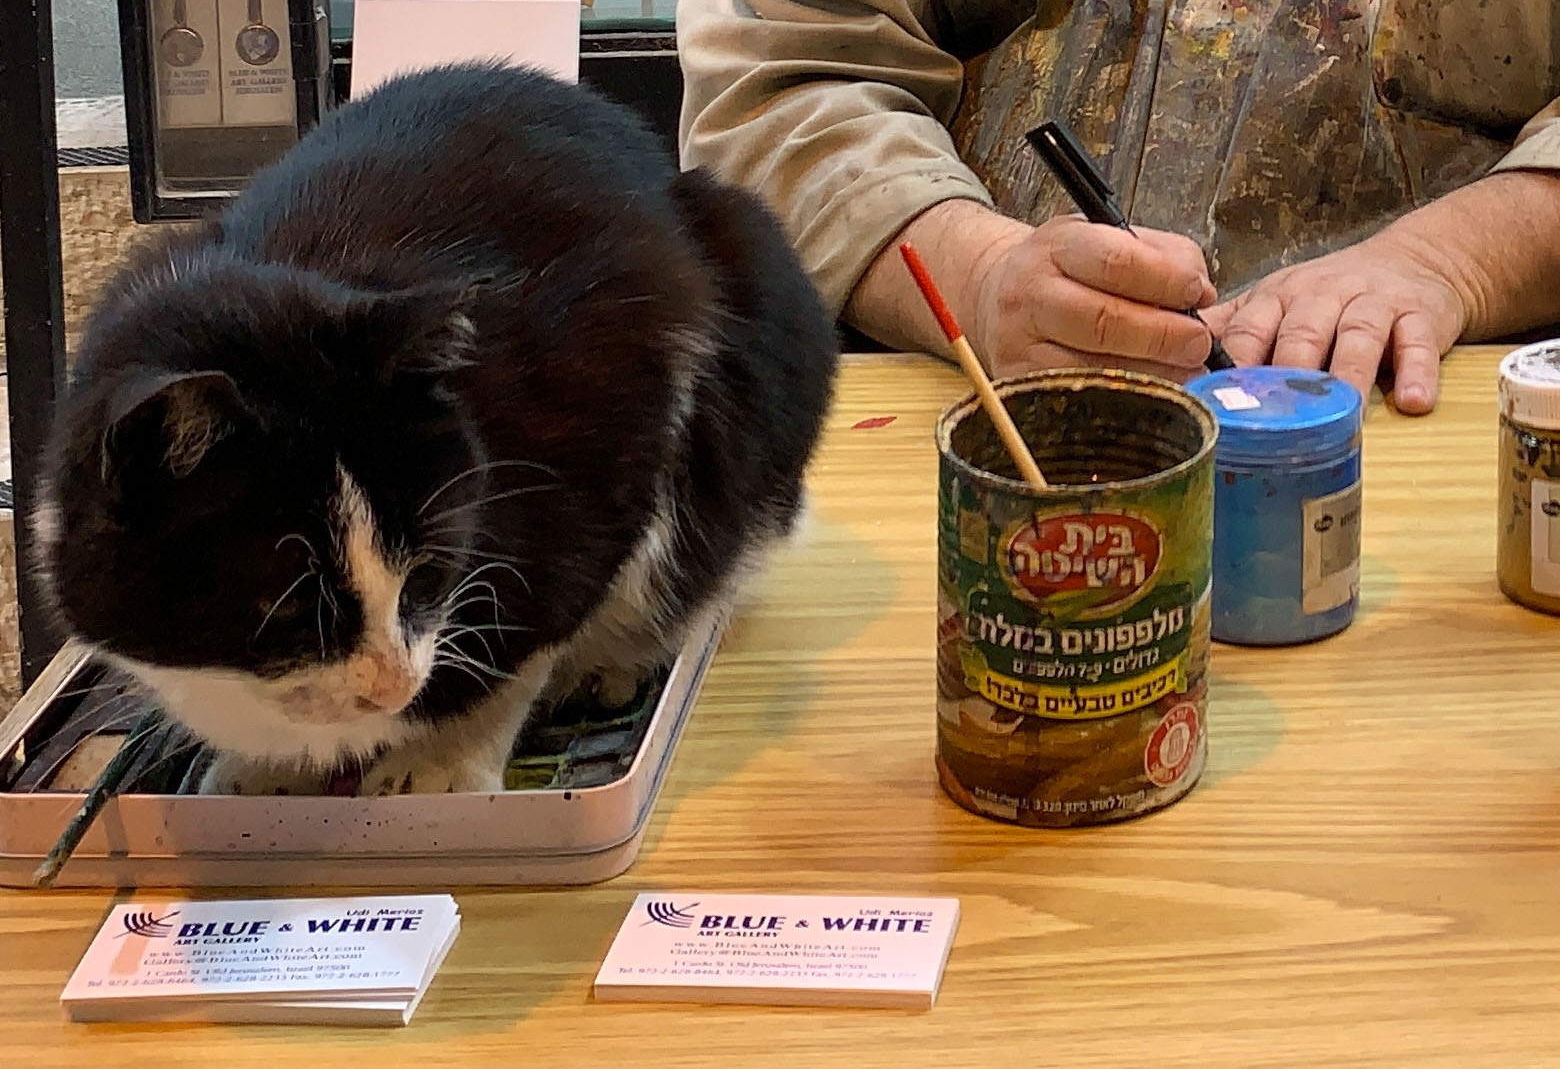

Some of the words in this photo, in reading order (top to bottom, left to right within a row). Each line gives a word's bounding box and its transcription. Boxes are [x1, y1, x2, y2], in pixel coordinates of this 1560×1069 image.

[1058, 522, 1136, 555] בית
[1013, 541, 1147, 587] השיטה
[1061, 606, 1184, 655] מלפפונים
[1113, 647, 1161, 674] גדולים
[1122, 668, 1177, 706] רכיבים
[1046, 693, 1116, 714] טבעיים
[346, 909, 370, 917] Udi
[700, 915, 787, 930] BLUE
[795, 919, 809, 928] &
[822, 917, 933, 933] WHITE
[178, 920, 271, 937] BLUE
[278, 923, 294, 932] &
[307, 916, 422, 933] WHITE
[173, 938, 199, 946] ART
[203, 937, 262, 945] GALLERY
